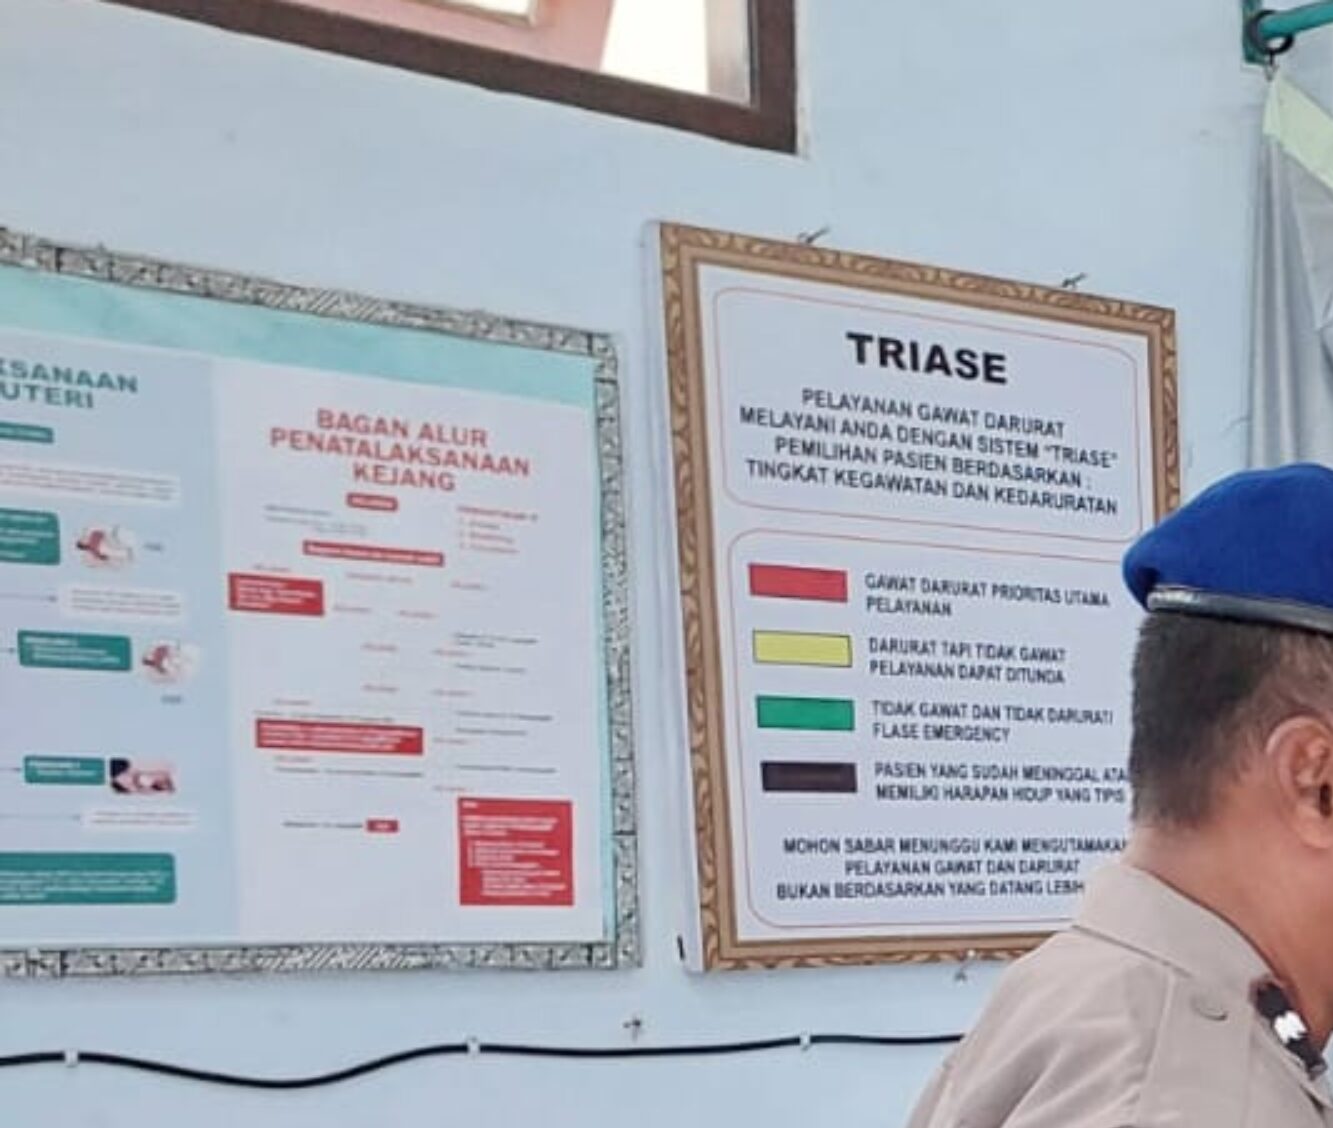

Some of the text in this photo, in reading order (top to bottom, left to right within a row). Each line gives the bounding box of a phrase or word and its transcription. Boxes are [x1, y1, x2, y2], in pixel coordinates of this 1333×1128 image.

[846, 332, 1008, 385] TRIASE
[0, 380, 94, 409] UTERI
[802, 388, 1064, 439] PELAYANAN GAWAT DARURAT
[317, 408, 488, 448] BAGAN ALUR
[740, 406, 835, 435] MELAYANI
[840, 421, 891, 441] ANDA
[897, 426, 972, 450] DENGAN
[977, 435, 1039, 459] SISTEM
[270, 427, 530, 477] PENATALAKSANAAN
[775, 436, 877, 464] PEMILIHAN
[882, 448, 947, 472] PASIEN
[952, 458, 1081, 488] BERDASARKAN
[353, 463, 456, 492] KEJANG
[746, 459, 1118, 515] TINGKAT KEGAWATAN DAN KEDARURATAN
[864, 572, 1111, 607] GAWAT DARURAT PRIORITAS UTAMA
[866, 595, 952, 617] PELAYANAN
[869, 637, 1066, 662] DARURAT TAPI TIDAK GAWAT
[869, 659, 1065, 684] PELAYANAN DAPAT DITUNDA
[872, 700, 915, 717] TIDAK
[919, 702, 968, 720] GAWAT
[972, 704, 1001, 721] DAN
[1003, 705, 1044, 723] TIDAK
[873, 723, 1011, 742] FLASE EMERGENCY
[874, 761, 1127, 783] PASIEN YANG SUDAH MENINGGAL ATA
[876, 783, 939, 801] MEMILIKI
[943, 784, 1009, 801] HARAPAN
[1012, 786, 1052, 802] HIDUP
[1055, 787, 1091, 803] YANG
[783, 837, 841, 854] MOHON
[844, 837, 895, 854] SABAR
[899, 838, 981, 854] MENUNGGU
[983, 838, 1018, 854] KAMI
[844, 859, 1081, 877] PELAYANAN GAWAT DAN DARURAT
[776, 882, 831, 900] BUKAN
[834, 880, 946, 899] BERDASARKAN
[949, 880, 986, 897] YANG
[988, 879, 1043, 897] DATANG
